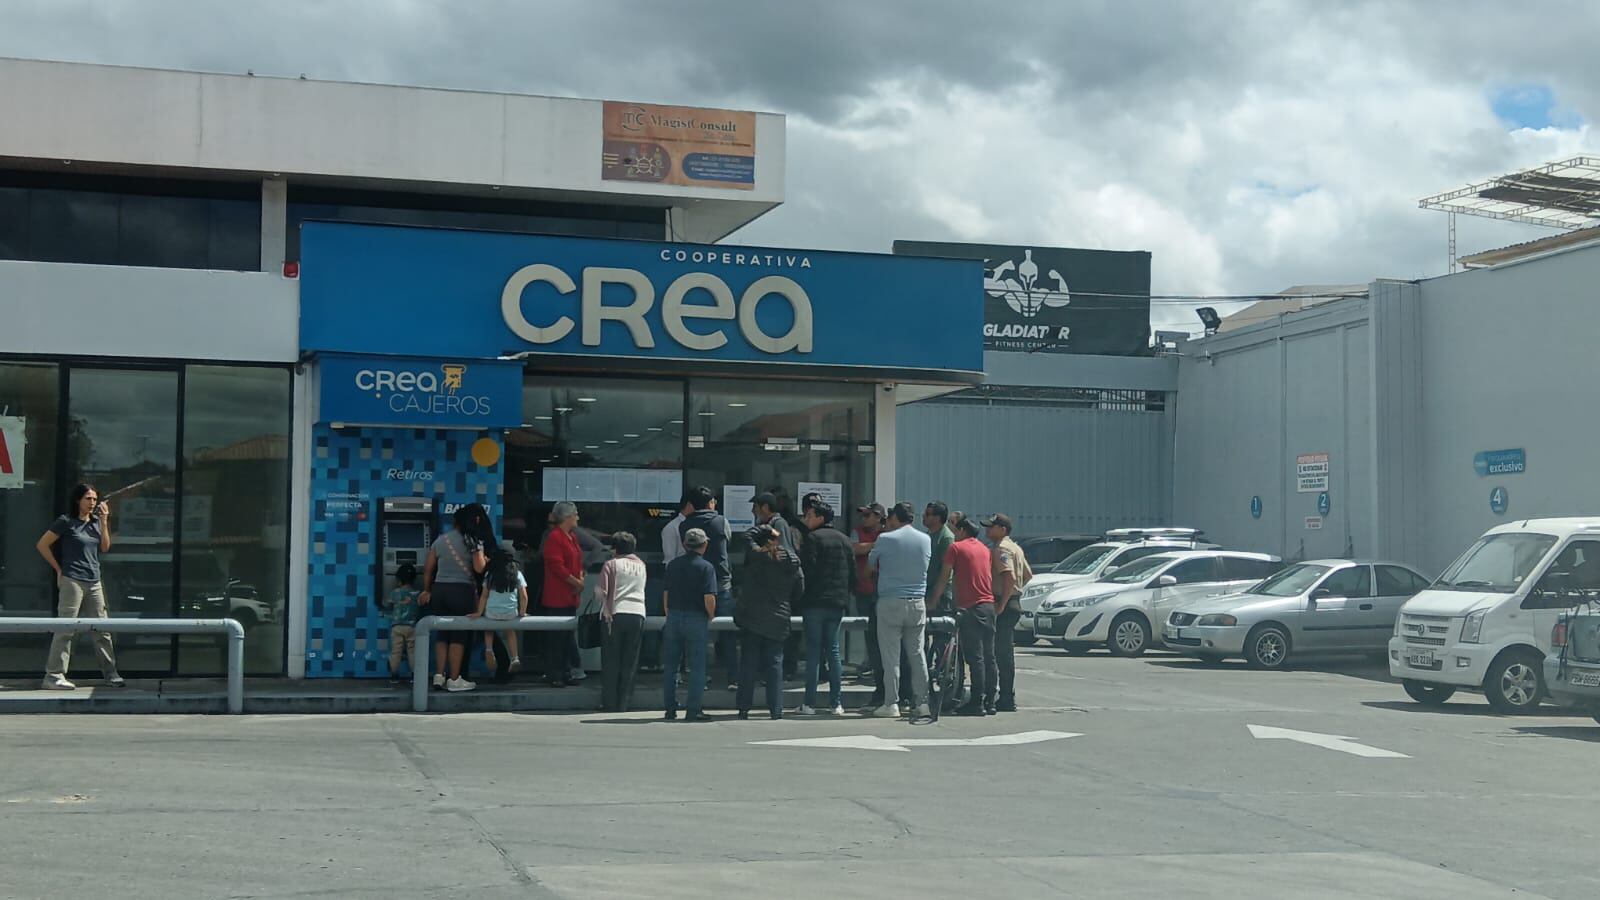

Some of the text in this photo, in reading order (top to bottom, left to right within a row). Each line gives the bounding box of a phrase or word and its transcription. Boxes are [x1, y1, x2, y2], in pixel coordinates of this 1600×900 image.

[660, 250, 811, 268] COOPERATIVA
[983, 324, 1070, 339] GLADIATR
[389, 393, 491, 415] CAJEROS
[386, 468, 433, 480] Retiros
[1490, 460, 1523, 473] exclusivo
[1320, 493, 1328, 507] 2
[1493, 489, 1502, 504] 4
